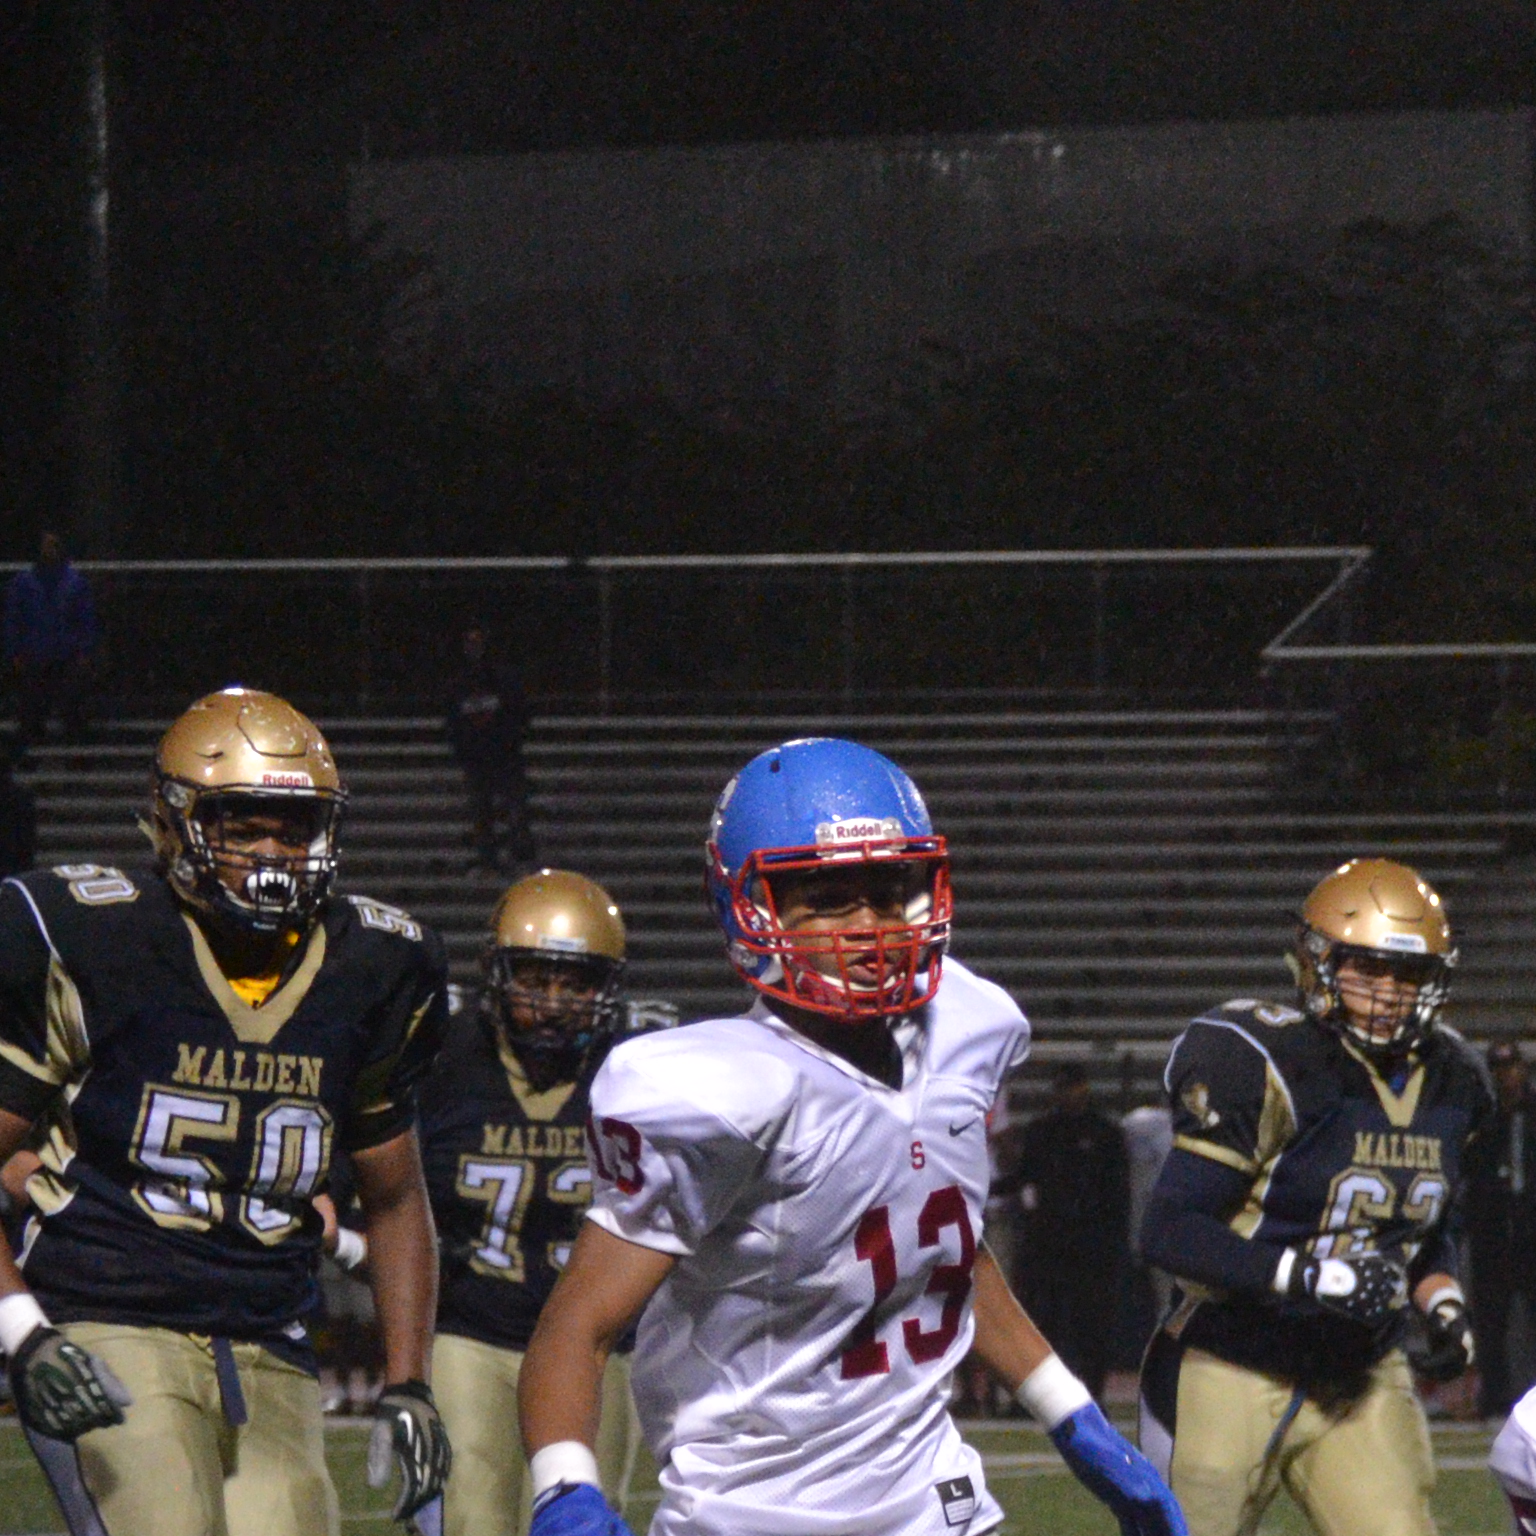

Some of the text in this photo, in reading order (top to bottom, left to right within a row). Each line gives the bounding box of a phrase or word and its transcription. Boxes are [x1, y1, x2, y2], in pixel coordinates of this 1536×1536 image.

[263, 774, 309, 786] Riddell
[836, 823, 882, 838] Riddell
[172, 1043, 323, 1097] MALDEN
[479, 1124, 592, 1155] MALDE
[1352, 1132, 1442, 1170] MALDEN
[128, 1081, 334, 1246] 50
[911, 1141, 926, 1170] S
[841, 1184, 976, 1380] 13
[950, 1482, 963, 1497] L
